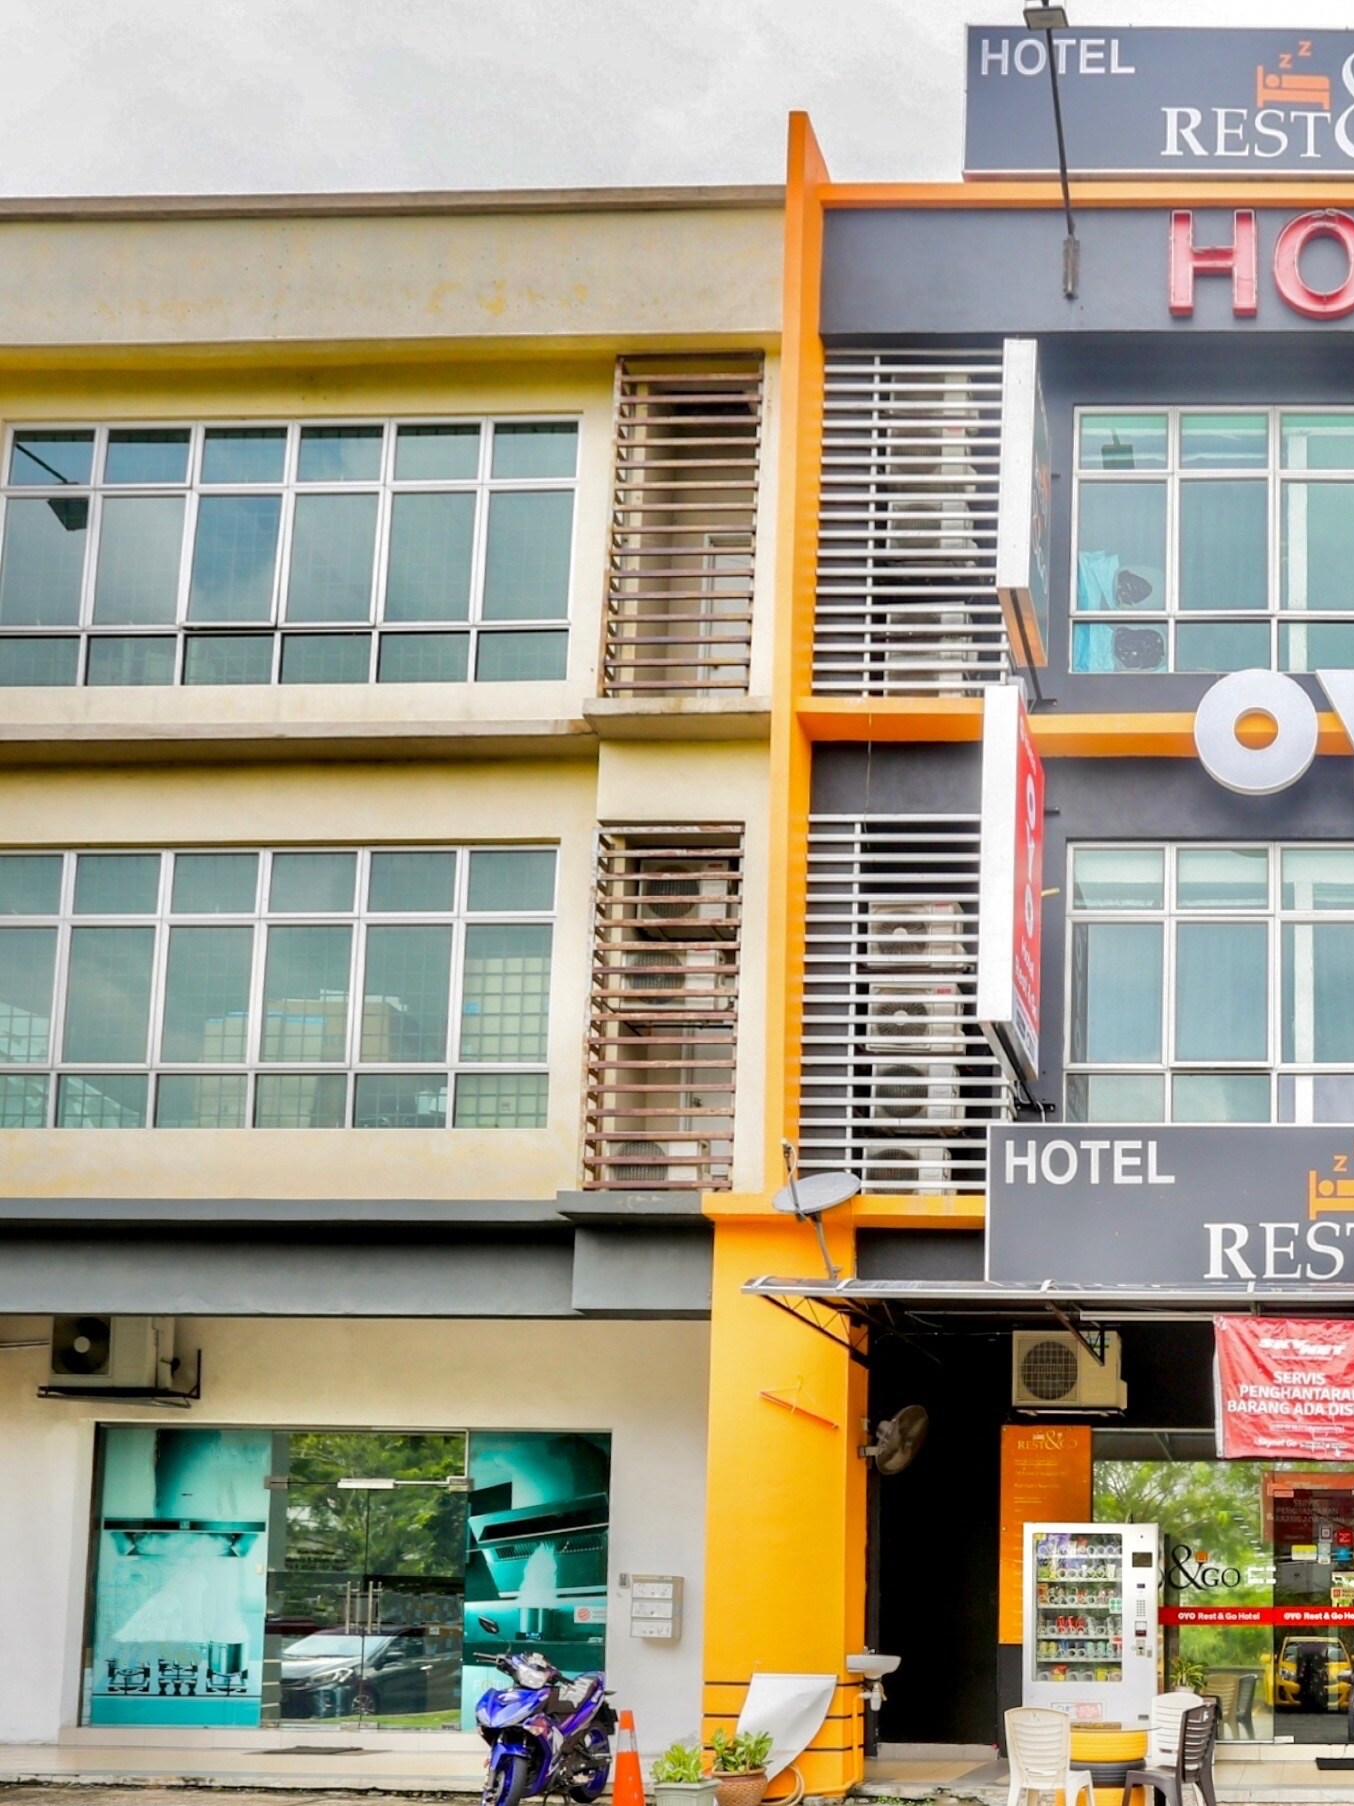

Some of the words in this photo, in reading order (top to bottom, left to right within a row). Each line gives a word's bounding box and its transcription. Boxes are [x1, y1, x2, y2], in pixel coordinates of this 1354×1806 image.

[981, 38, 1136, 76] HOTEL
[1004, 1139, 1176, 1185] HOTEL
[1273, 1371, 1327, 1386] SERVIS
[1227, 1401, 1291, 1416] BARANG
[1293, 1402, 1325, 1417] ADA
[1198, 1612, 1217, 1621] Rest
[1225, 1612, 1238, 1621] Go
[1238, 1612, 1260, 1621] Hotel
[1303, 1612, 1322, 1621] Rest
[1330, 1612, 1344, 1621] Go
